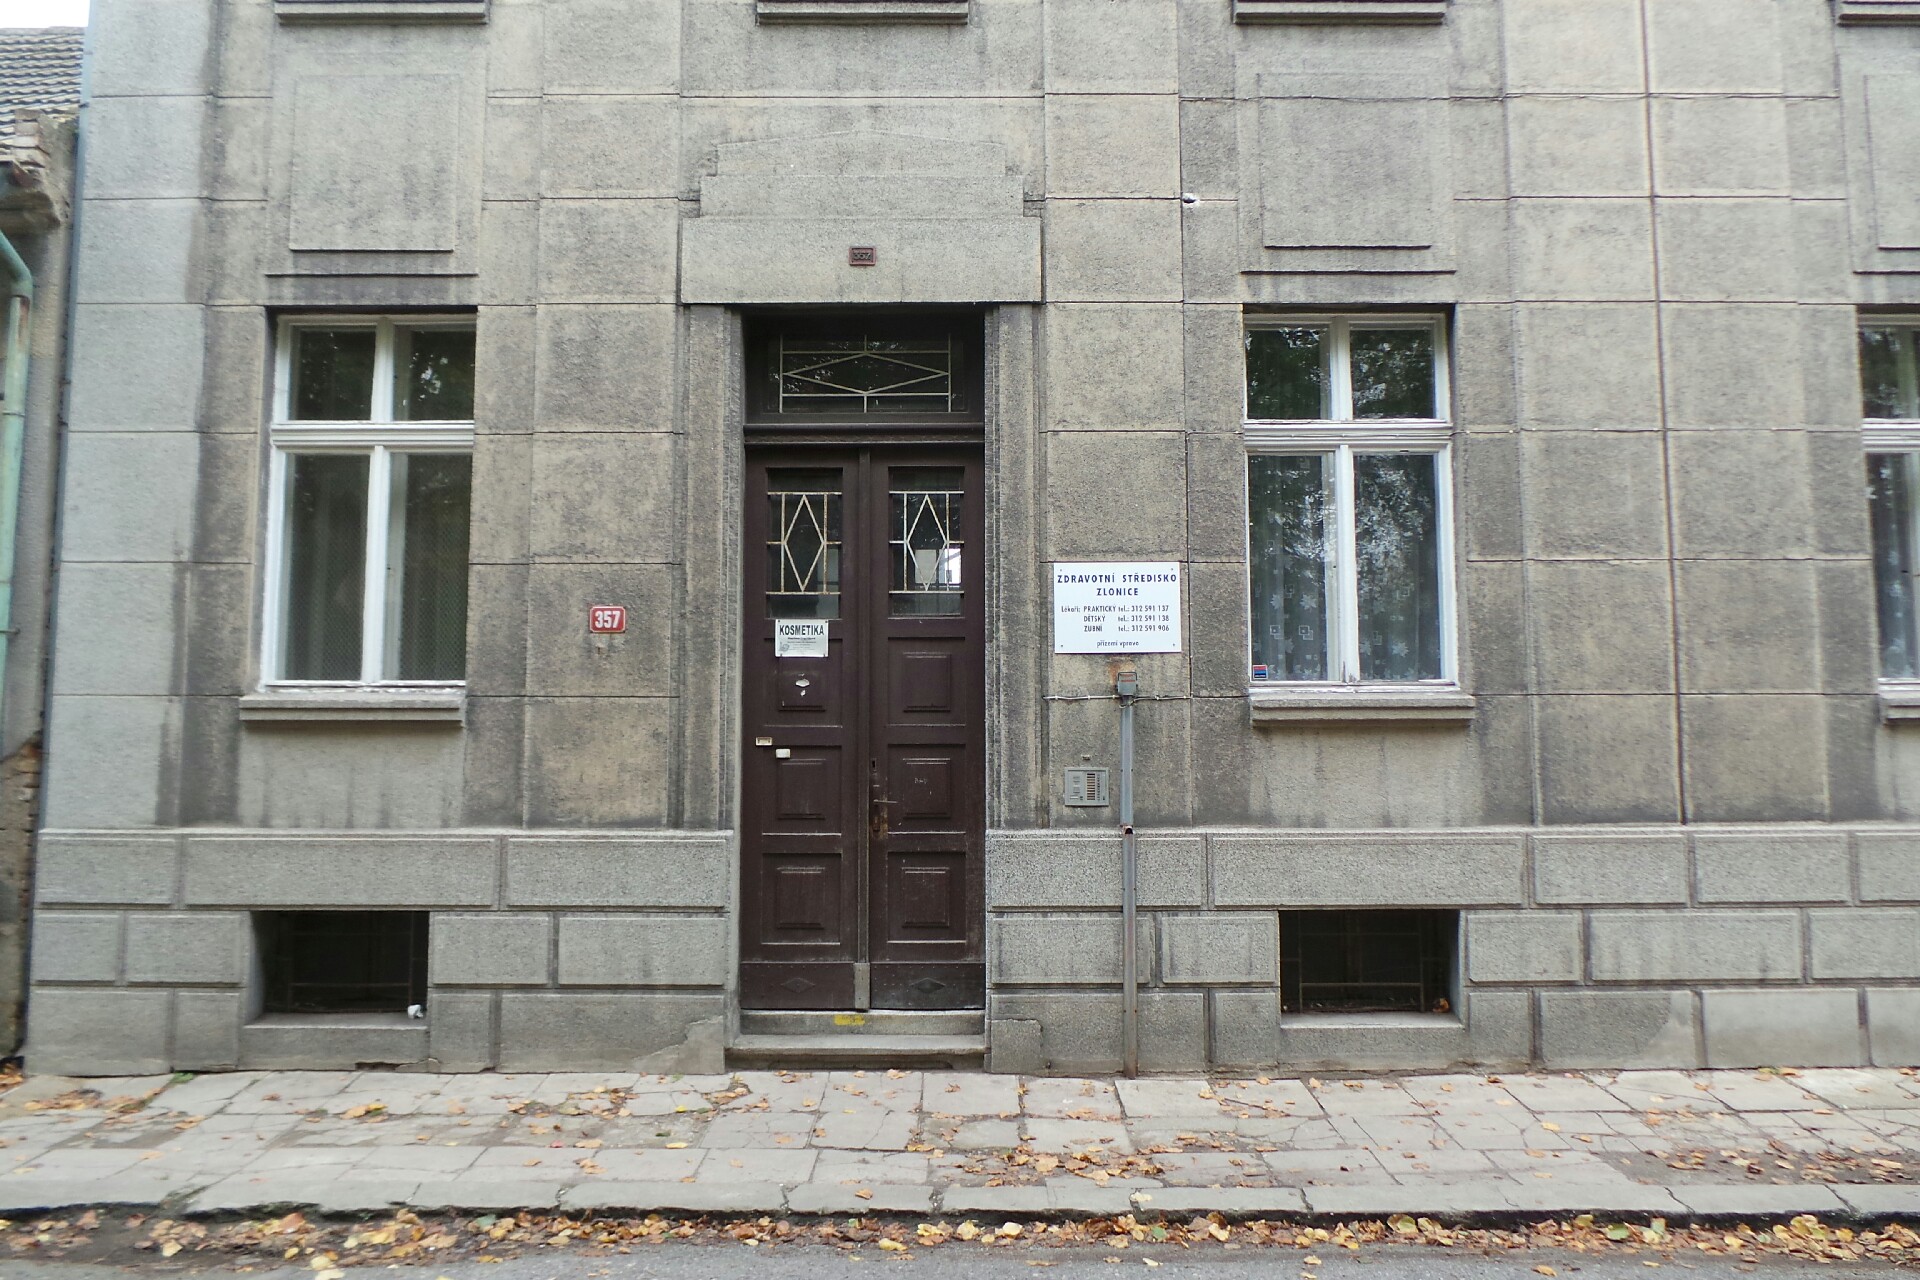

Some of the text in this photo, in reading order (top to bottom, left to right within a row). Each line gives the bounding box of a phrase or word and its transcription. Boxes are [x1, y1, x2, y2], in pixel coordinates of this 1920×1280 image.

[1057, 572, 1177, 583] ZDRAVOTNÍ STŘEDISKO
[1096, 587, 1139, 596] ZLONICE
[1083, 604, 1117, 613] PRAKTICKÝ
[595, 610, 620, 628] 357
[1083, 613, 1170, 622] DĚTSKÝ tel.: 312 591 138
[779, 624, 825, 636] KOSMETIKA
[1083, 624, 1170, 633] ZUBNÍ tel.: 312 591 906
[1096, 639, 1118, 648] přízemí
